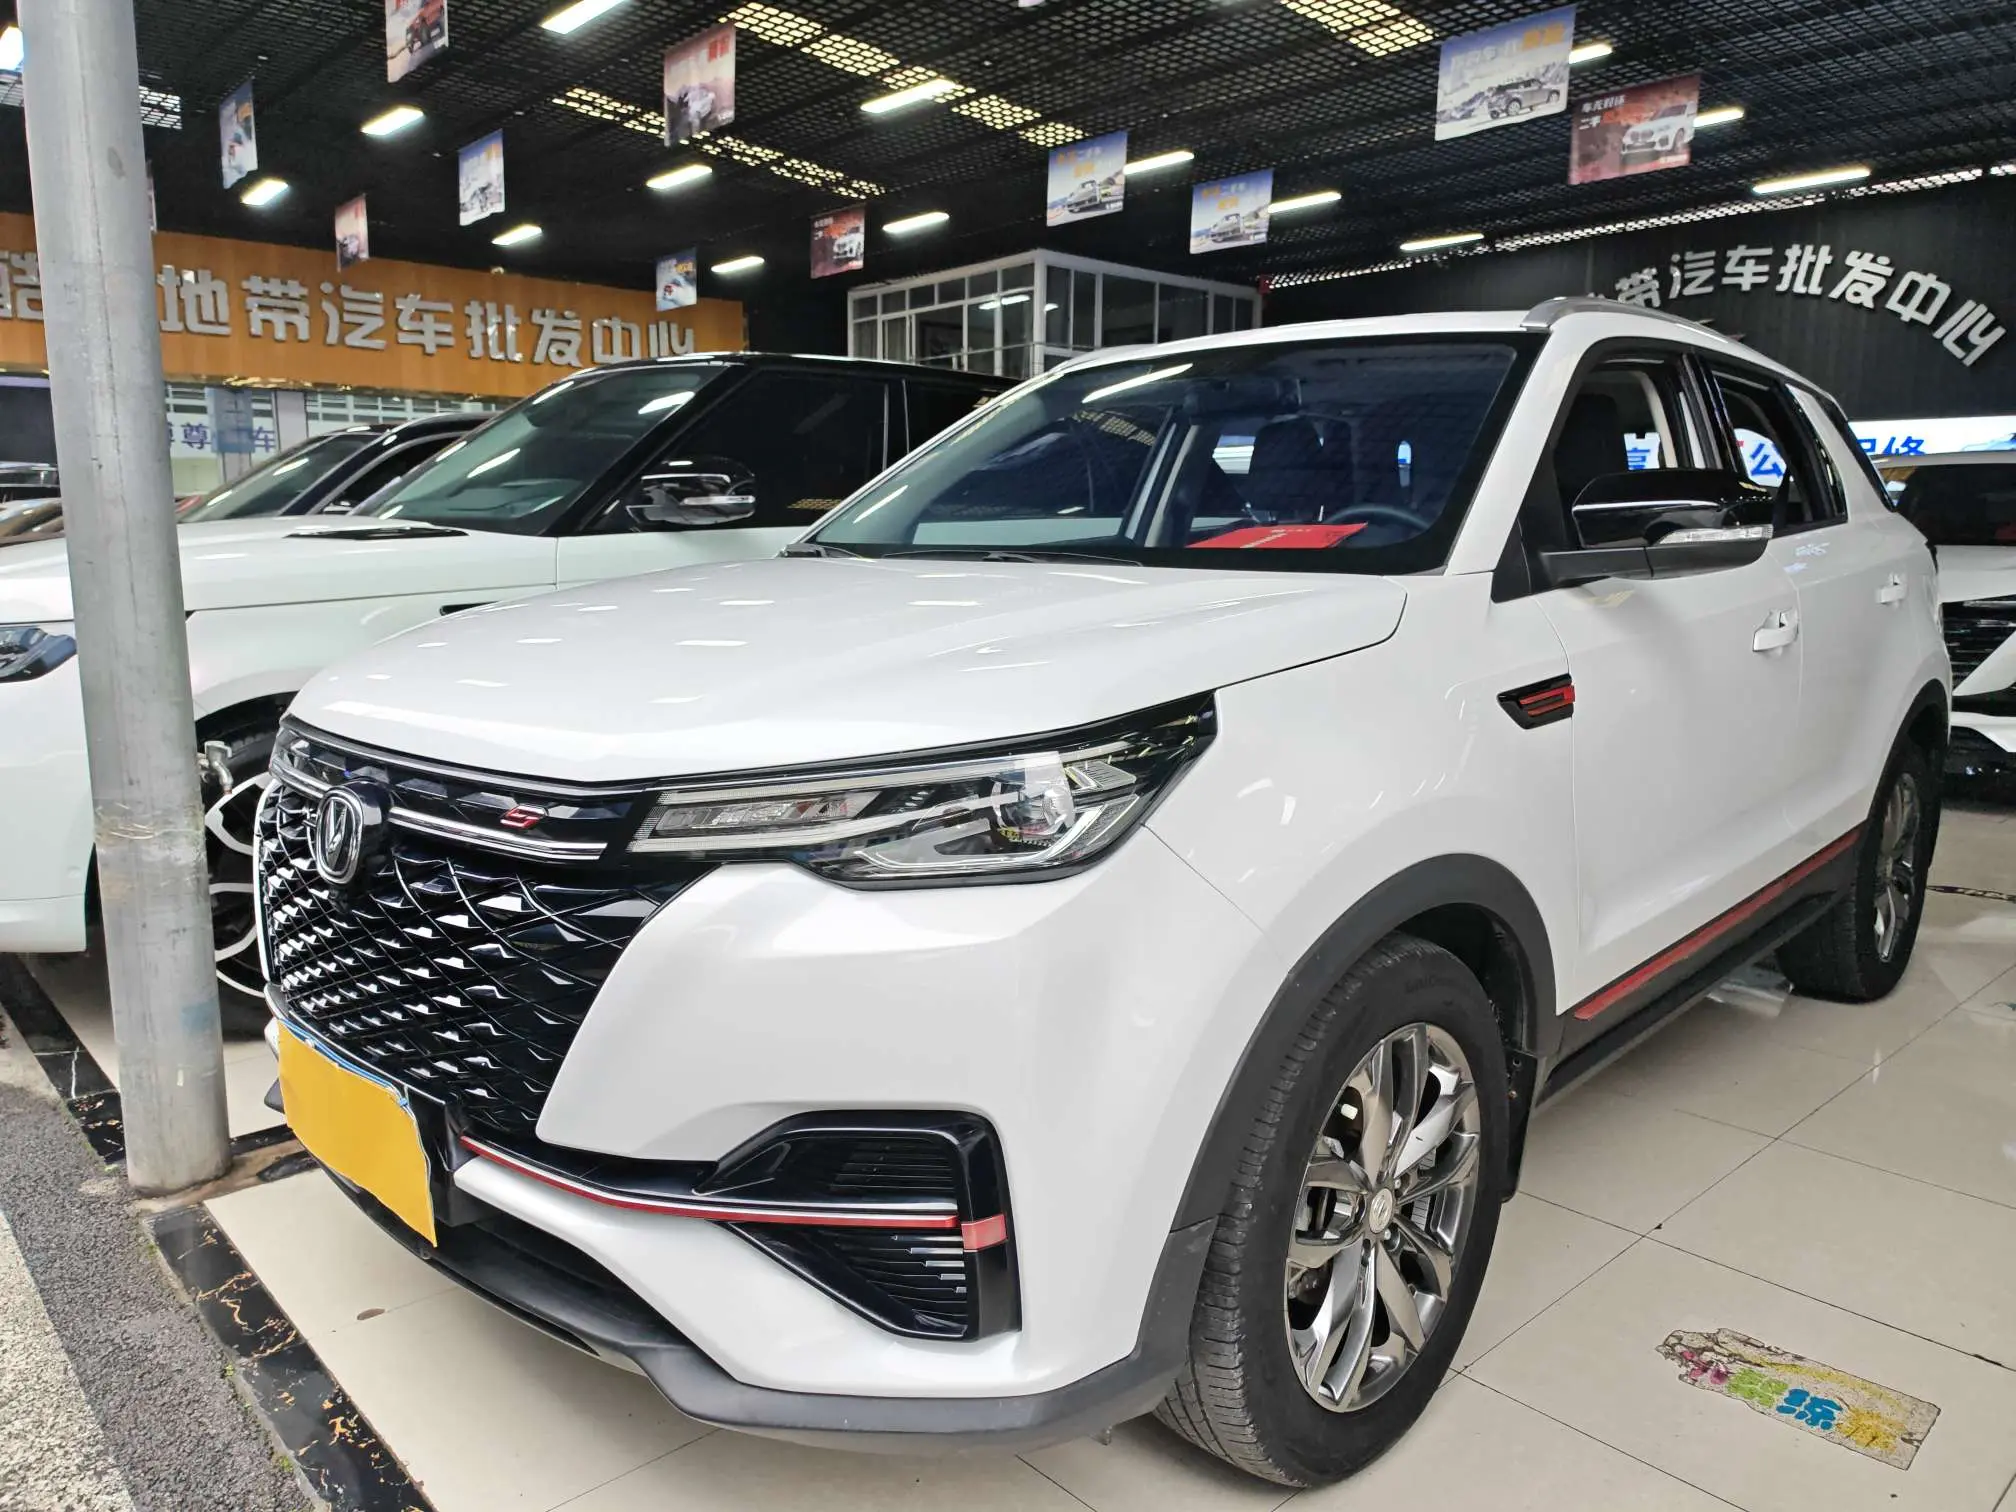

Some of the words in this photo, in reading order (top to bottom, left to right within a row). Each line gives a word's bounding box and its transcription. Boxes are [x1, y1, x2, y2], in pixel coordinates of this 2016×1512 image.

[1590, 244, 2007, 367] 带汽车批发中心
